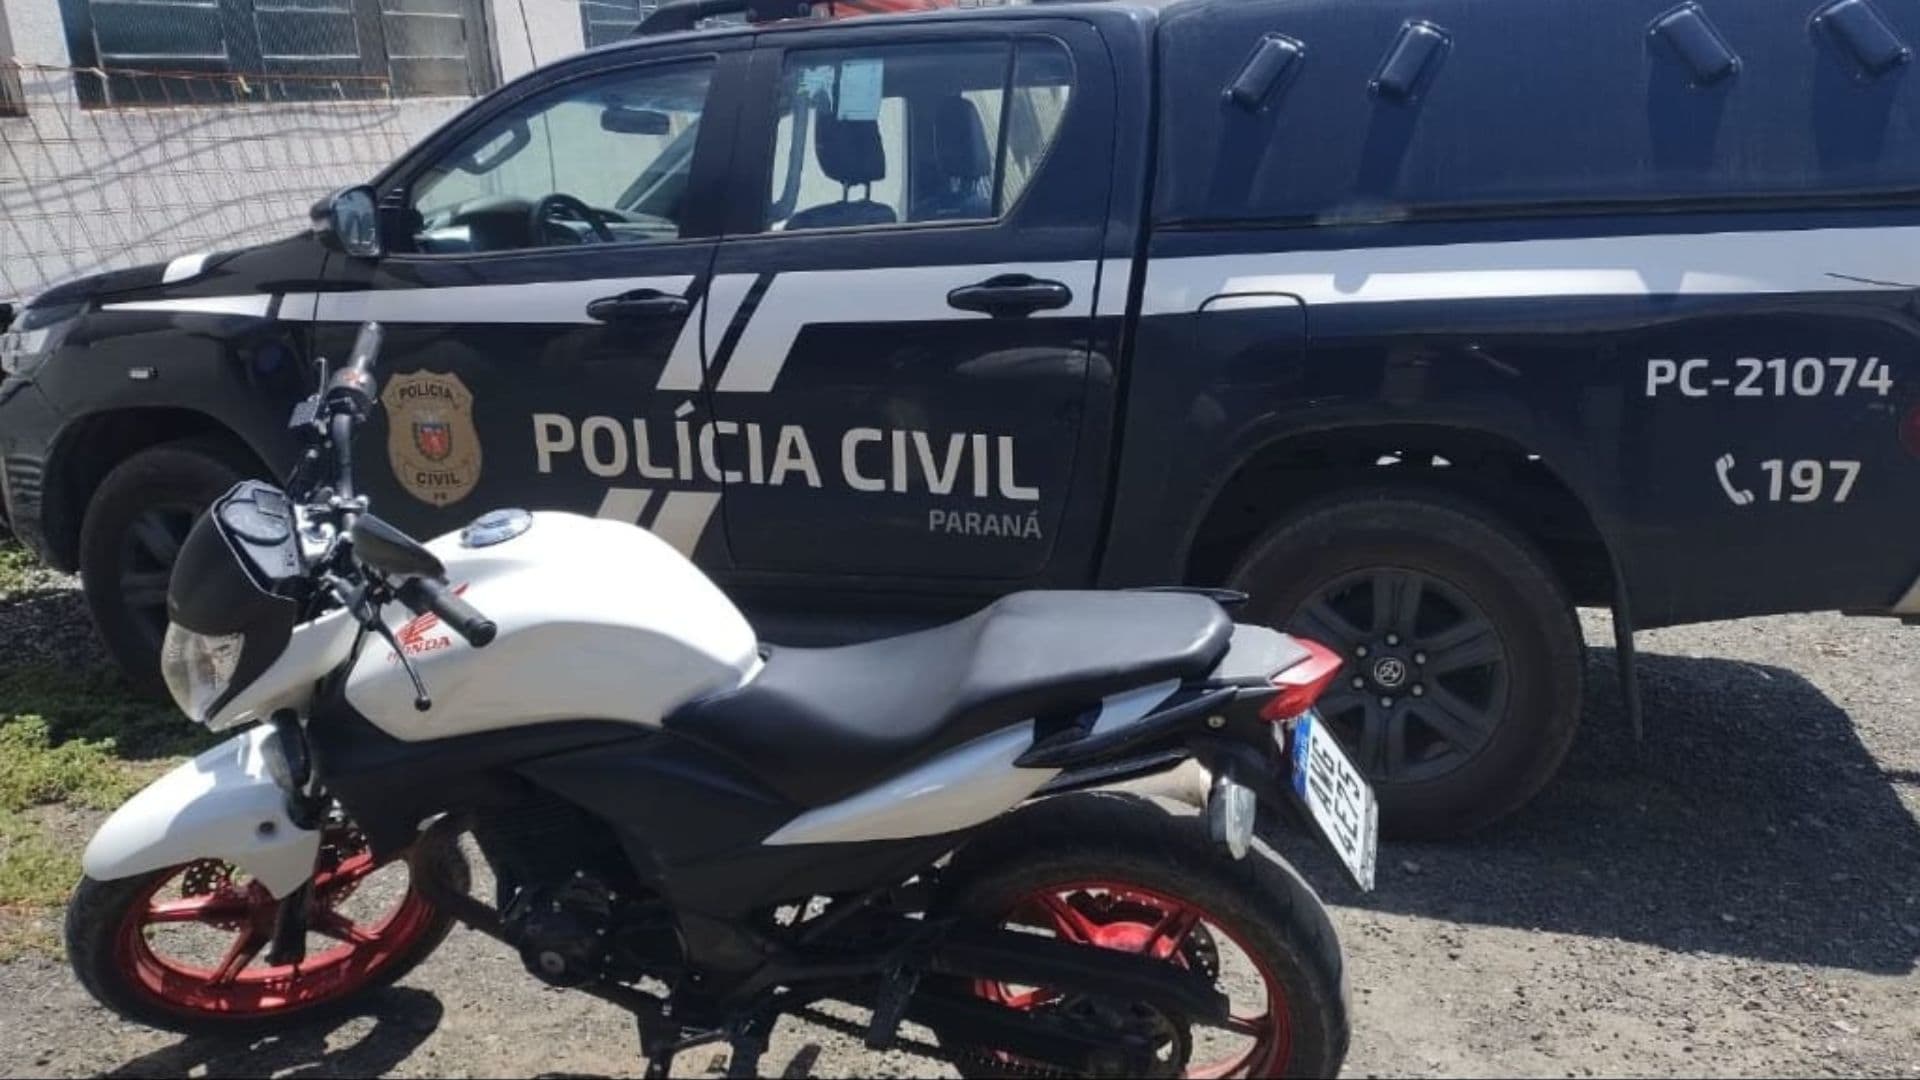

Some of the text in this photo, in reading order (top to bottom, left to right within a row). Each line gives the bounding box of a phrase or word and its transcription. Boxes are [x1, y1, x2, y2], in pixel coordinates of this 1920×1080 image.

[399, 382, 454, 400] POLÍCIA
[1646, 357, 1894, 397] PC-21074
[533, 400, 1040, 500] POLÍCIA CIVIL
[416, 472, 461, 486] CIVIL
[1760, 459, 1862, 502] 197
[928, 508, 1043, 539] PARANÁ
[1333, 760, 1361, 853] 4E75
